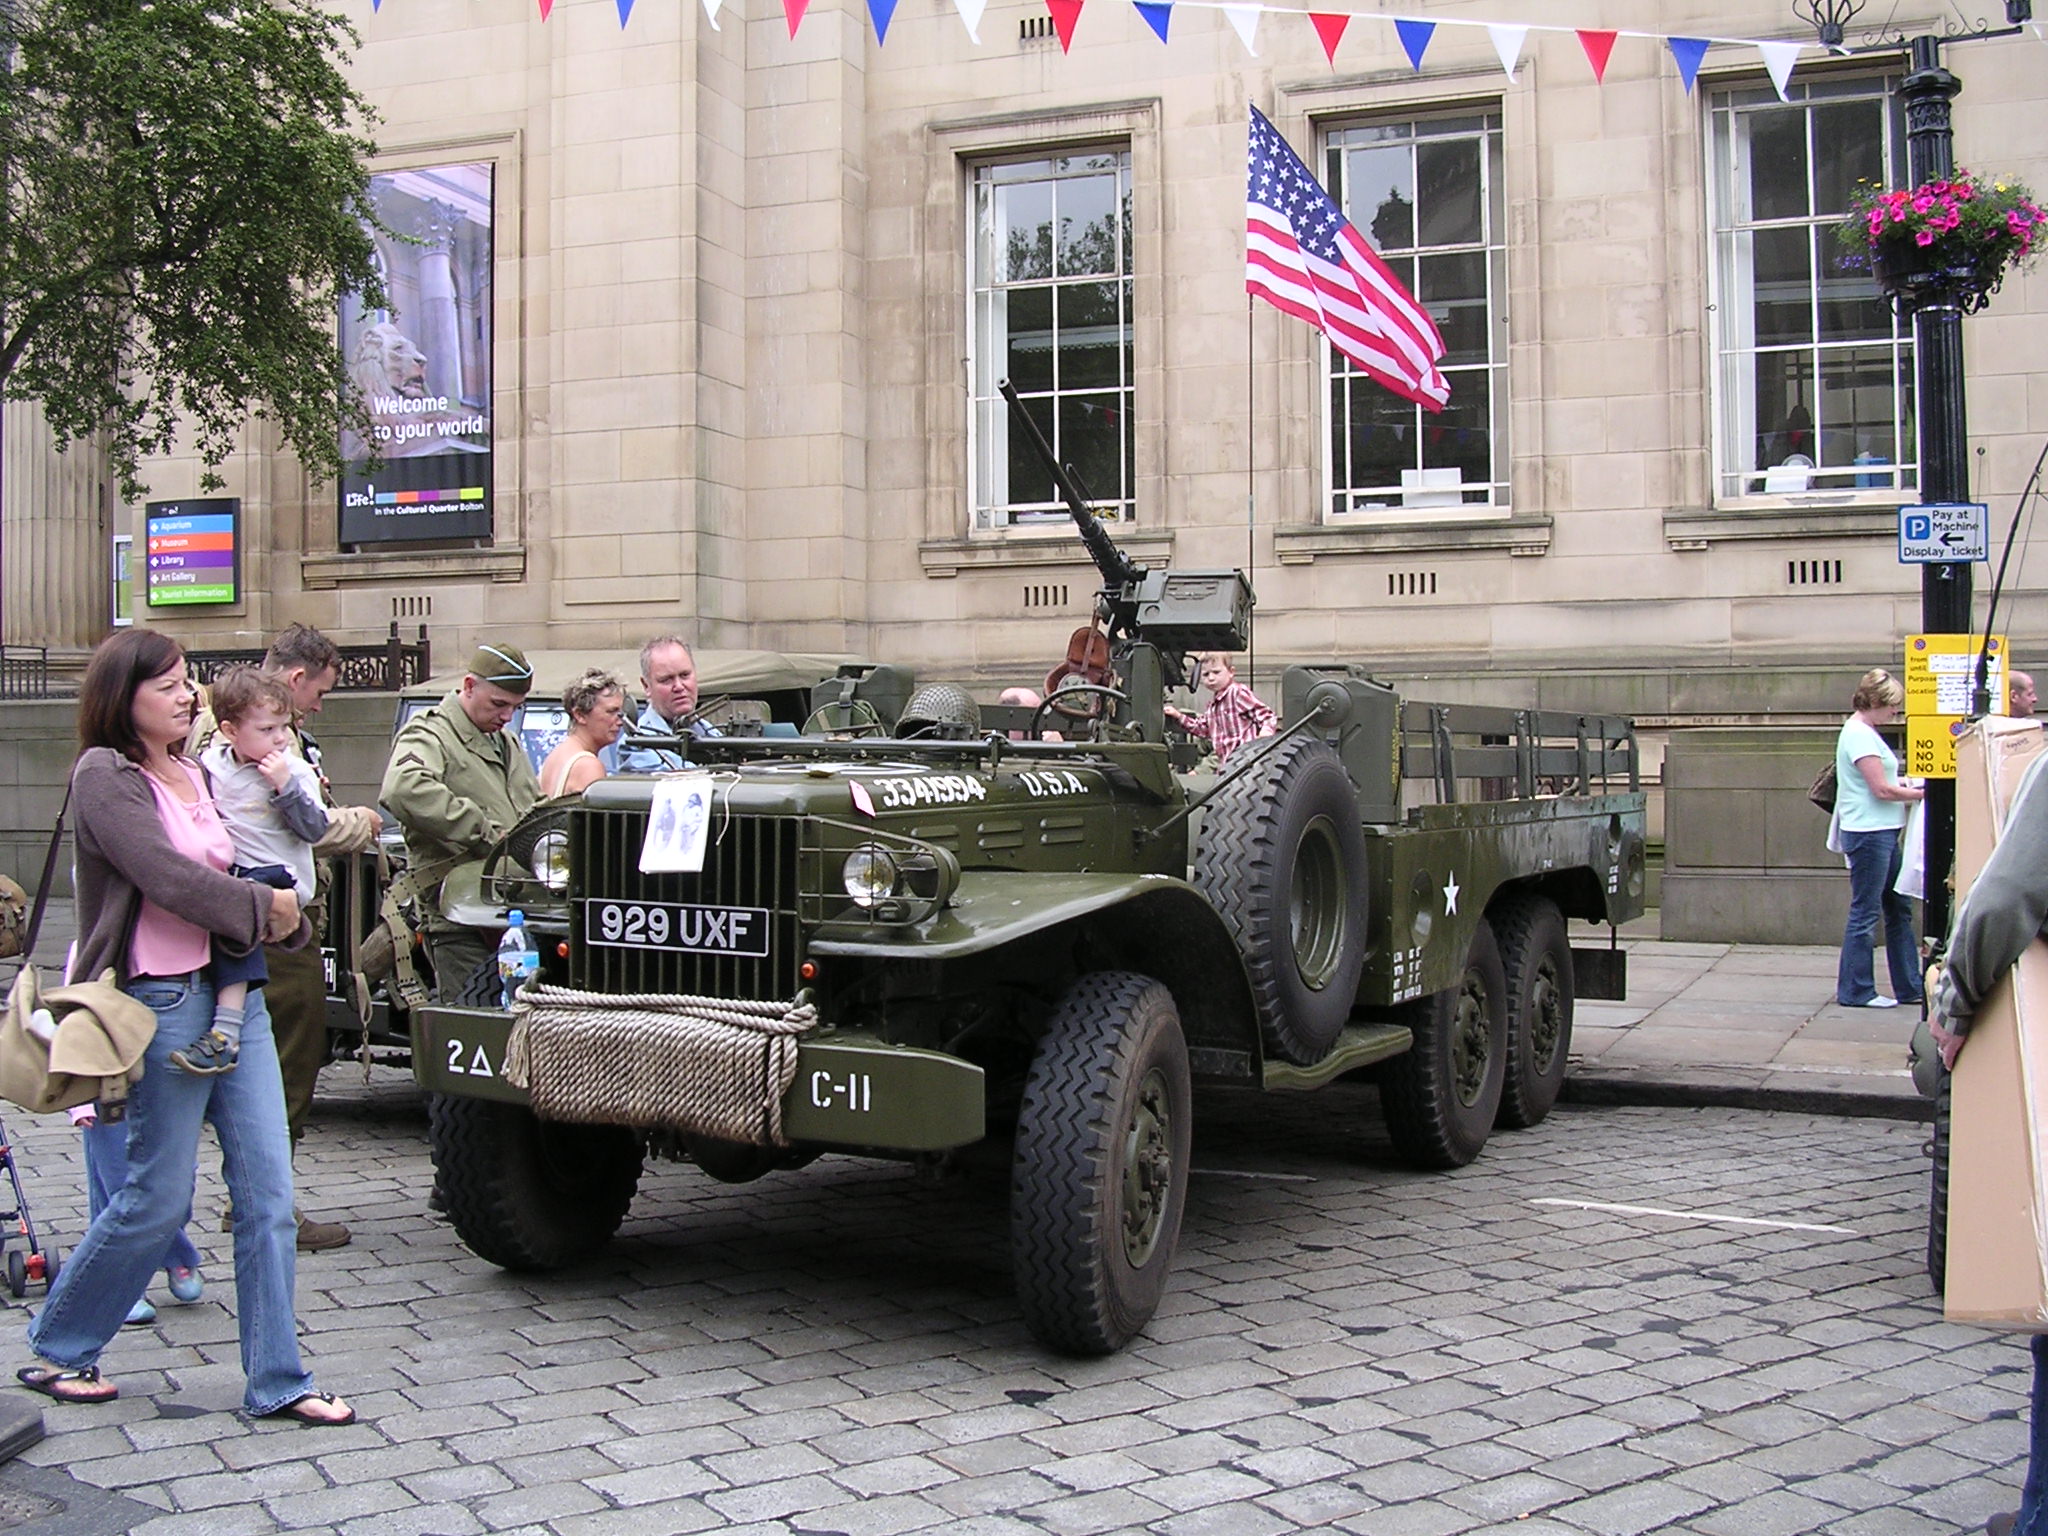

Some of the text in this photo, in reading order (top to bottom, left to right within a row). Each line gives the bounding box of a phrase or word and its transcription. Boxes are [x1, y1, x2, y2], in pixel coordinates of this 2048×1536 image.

[374, 395, 448, 415] Welcome
[374, 415, 483, 444] to your world
[346, 484, 375, 507] Life!
[383, 507, 395, 515] the
[396, 504, 428, 515] Cultural
[428, 503, 459, 514] Quarter
[460, 502, 484, 512] Bolton
[1932, 510, 1968, 522] Pay at
[161, 521, 192, 532] Aquarium
[1932, 521, 1979, 532] Machine
[161, 539, 188, 547] Museum
[1904, 546, 1983, 558] Display ticket
[161, 556, 184, 566] Library
[161, 571, 196, 583] Art Gallery
[1940, 565, 1951, 579] 2
[161, 588, 228, 598] Tourist Information
[1916, 739, 1934, 749] NO
[1916, 751, 1934, 761] NO
[1916, 763, 1934, 773] NO
[873, 770, 1089, 807] 3341994 U.S.A.
[601, 904, 752, 949] 929 UXF
